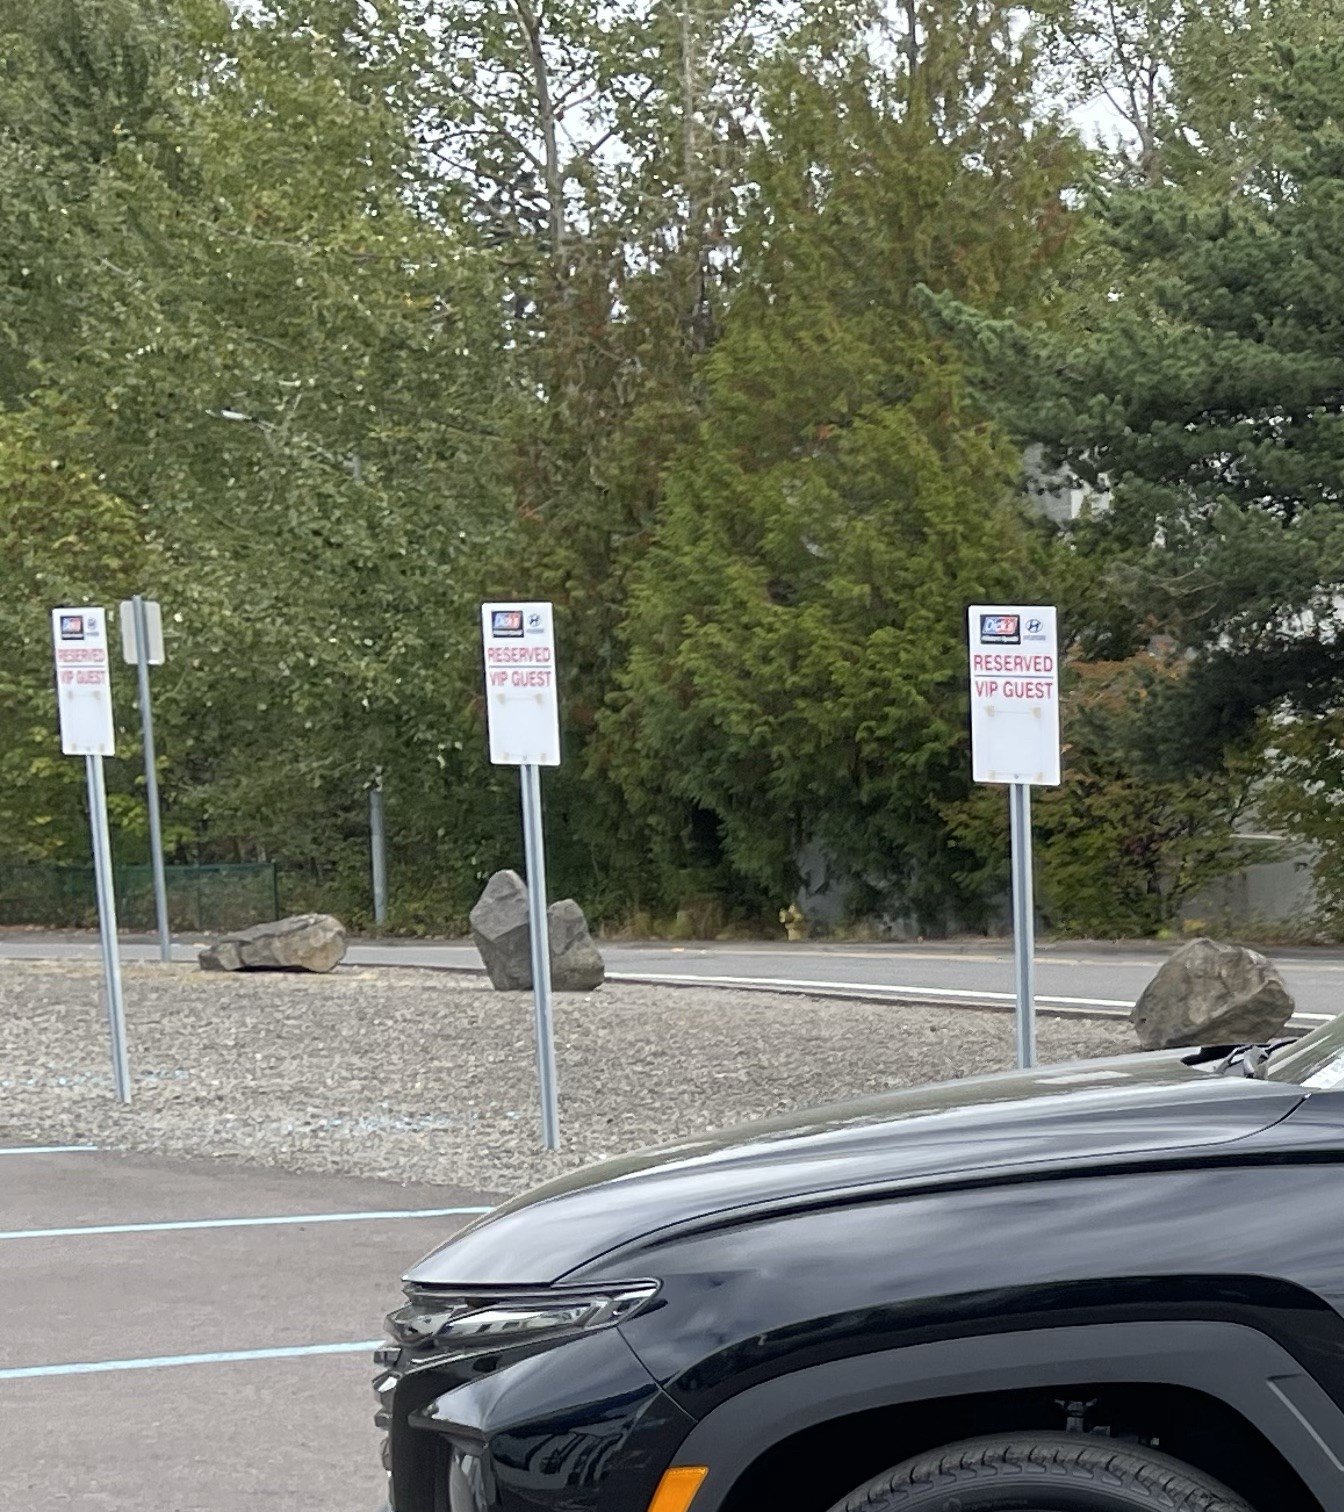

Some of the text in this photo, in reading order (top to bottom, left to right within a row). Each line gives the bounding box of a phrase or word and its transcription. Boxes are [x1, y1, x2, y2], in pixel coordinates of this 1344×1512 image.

[488, 647, 551, 662] RESERVED
[973, 655, 1053, 672] RESERVED
[489, 671, 551, 687] VIP GUEST
[975, 681, 1053, 699] VIP GUEST
